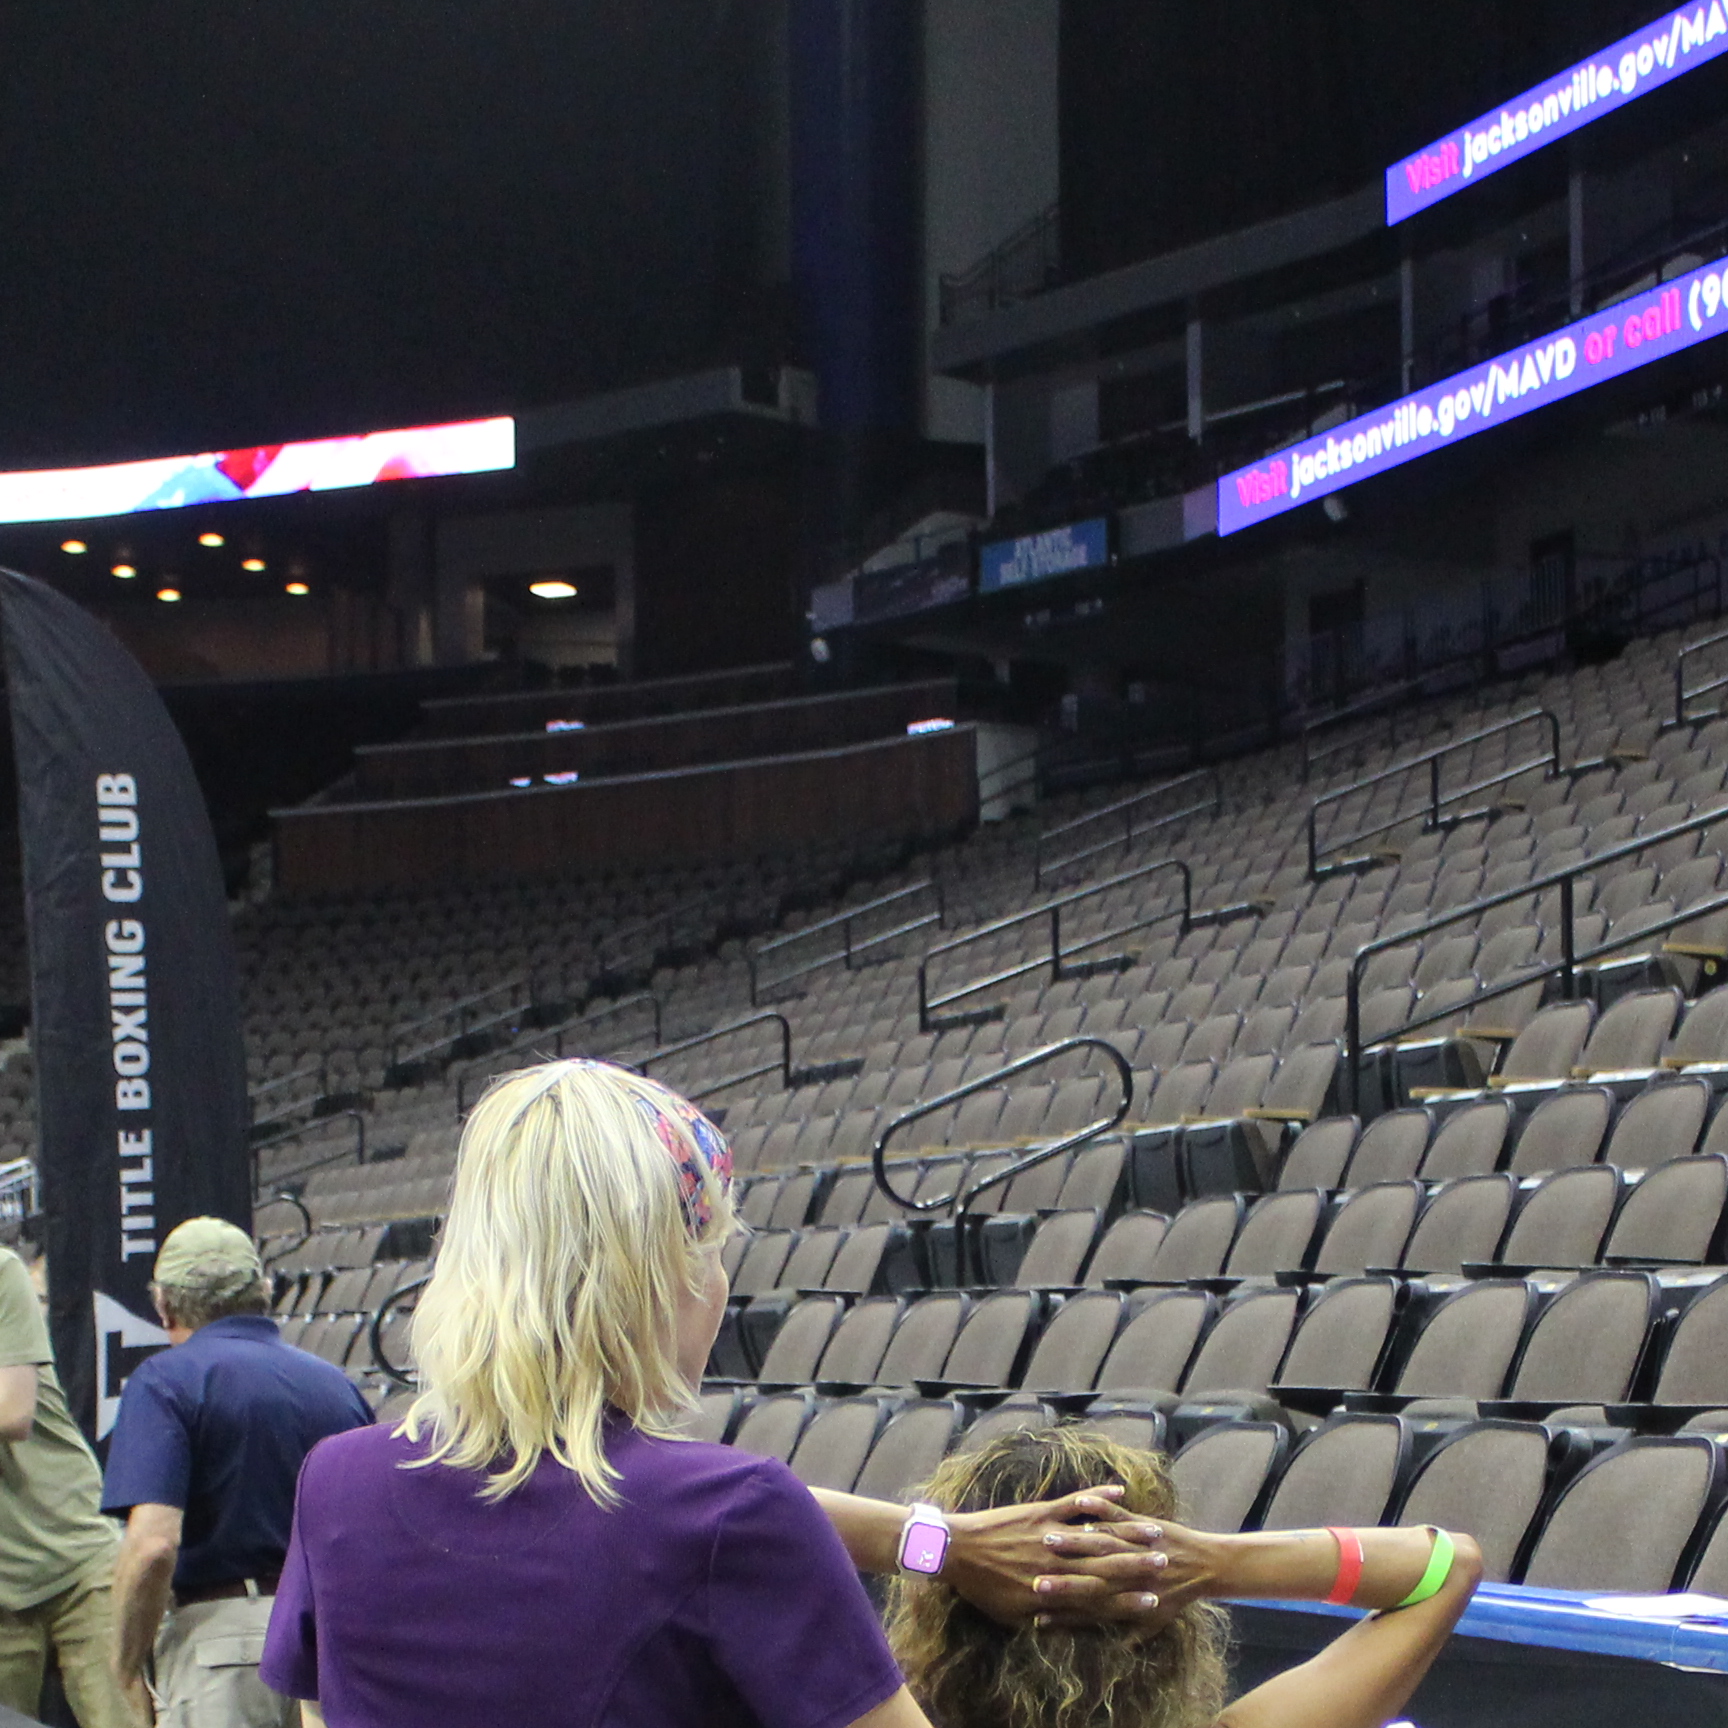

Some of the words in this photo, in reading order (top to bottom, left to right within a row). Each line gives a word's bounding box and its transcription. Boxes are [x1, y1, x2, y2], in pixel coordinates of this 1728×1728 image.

[1405, 141, 1460, 194] Visit
[1235, 460, 1289, 507] Visit
[1289, 336, 1577, 499] jacksonville.gov/MAVD
[1583, 325, 1619, 365] or
[1622, 287, 1683, 349] call
[95, 772, 144, 904] CLUB
[105, 917, 152, 1112] BOXING
[118, 1128, 156, 1263] TITLE
